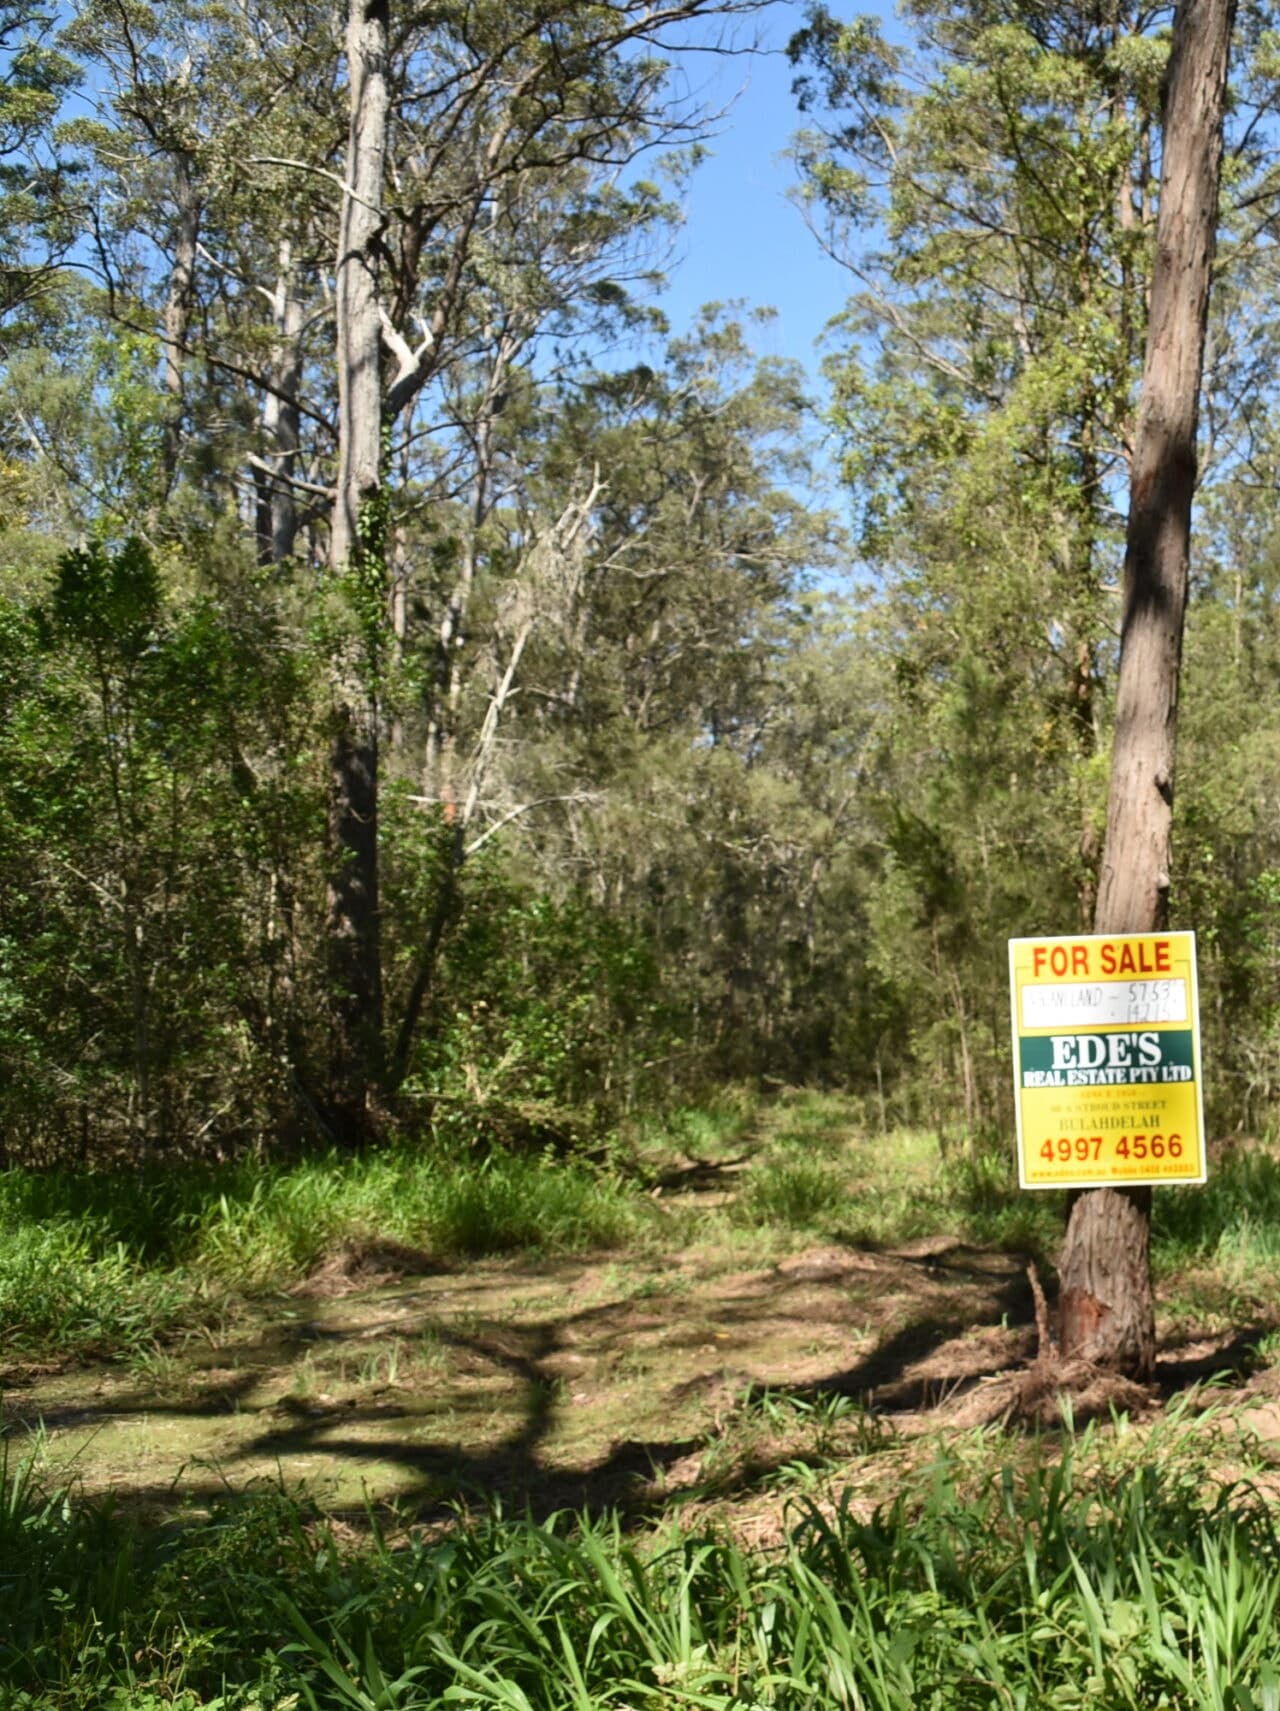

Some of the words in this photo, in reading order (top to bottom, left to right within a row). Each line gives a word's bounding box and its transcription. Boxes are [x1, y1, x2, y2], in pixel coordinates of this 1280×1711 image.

[1033, 945, 1090, 977] FOR
[1100, 941, 1172, 975] SALE
[1050, 1032, 1163, 1069] EDE'S
[1023, 1070, 1066, 1088] REAL
[1067, 1067, 1128, 1086] ESTATE
[1129, 1065, 1160, 1083] PTY
[1161, 1064, 1193, 1081] LTD
[1122, 1100, 1167, 1111] STREET
[1059, 1114, 1160, 1131] BULAHDELAH
[1040, 1136, 1103, 1162] 4997
[1115, 1134, 1183, 1159] 4566
